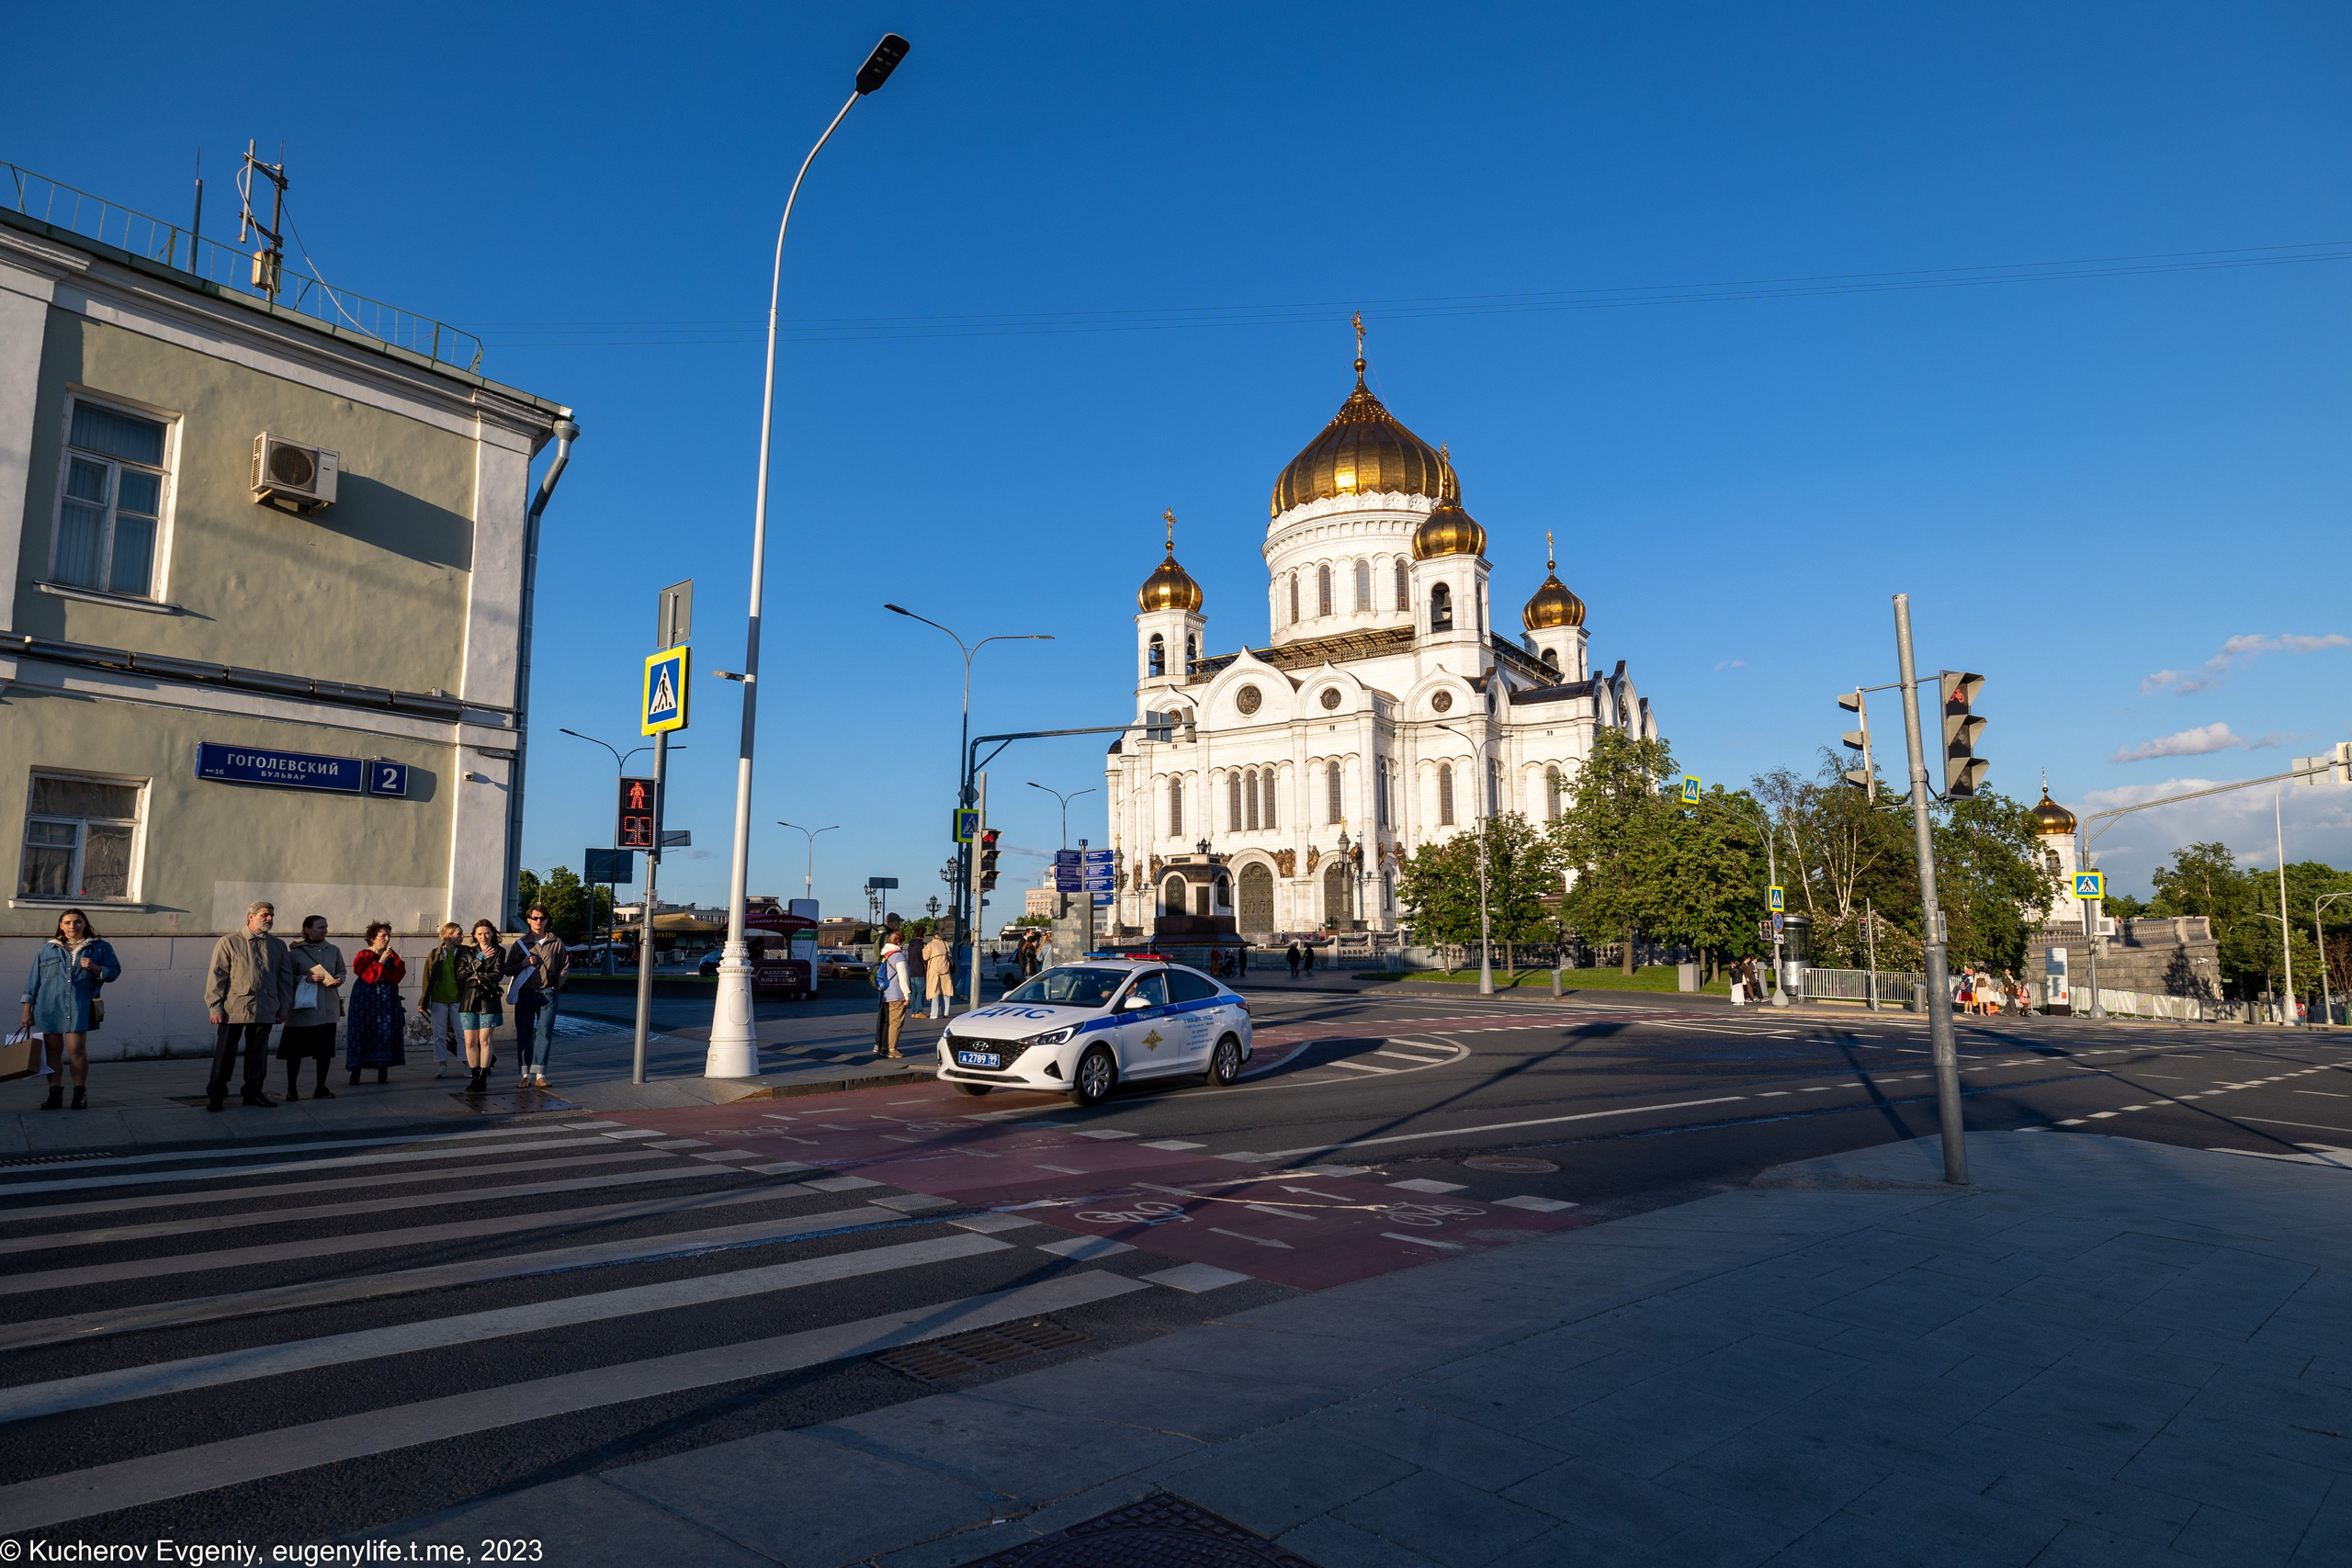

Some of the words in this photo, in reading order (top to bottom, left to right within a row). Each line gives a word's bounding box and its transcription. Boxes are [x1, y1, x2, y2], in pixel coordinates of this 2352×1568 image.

[227, 753, 339, 775] ГОГОЛЕВСКИЙ
[261, 771, 306, 781] БУЛЬВАР
[381, 768, 398, 789] 2
[970, 1006, 1055, 1019] ДПС
[968, 1053, 987, 1064] 2789
